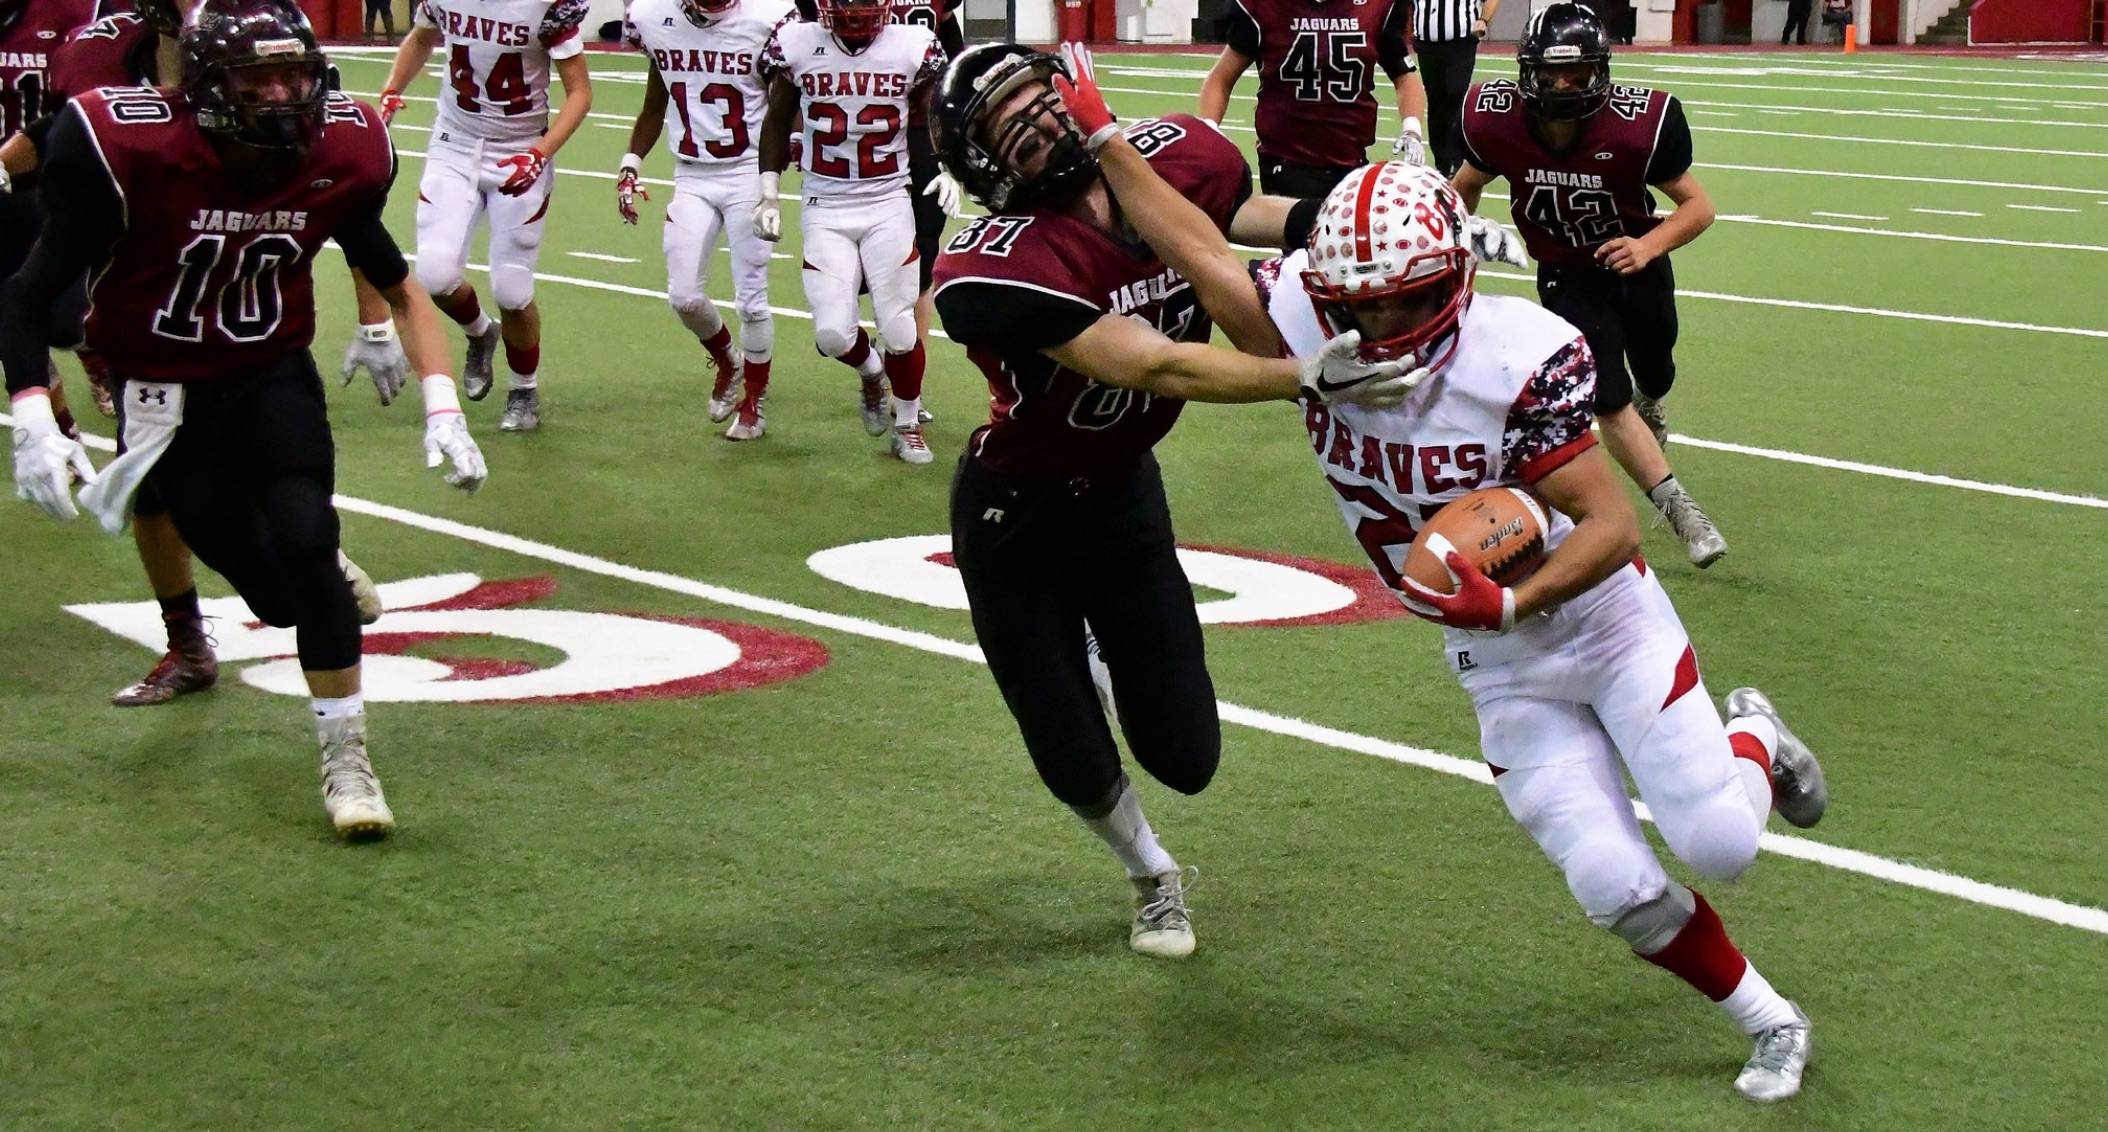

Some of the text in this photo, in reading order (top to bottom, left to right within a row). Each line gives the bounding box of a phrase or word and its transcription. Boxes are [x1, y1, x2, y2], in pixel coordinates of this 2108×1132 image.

[1290, 18, 1360, 31] JAGUARS
[449, 43, 533, 116] 44
[653, 49, 753, 75] BRAVES
[800, 72, 907, 97] BRAVES
[1279, 31, 1367, 103] 45
[0, 70, 45, 140] 1
[97, 86, 173, 125] 10
[670, 82, 750, 159] 13
[808, 102, 902, 180] 22
[1122, 119, 1188, 158] 8
[1524, 168, 1603, 189] JAGUARS
[190, 208, 309, 232] JAGUARS
[945, 216, 1036, 257] 87
[1525, 185, 1625, 249] 42
[152, 233, 304, 343] 10
[1305, 401, 1488, 495] BRAVES
[1326, 473, 1452, 592] 2
